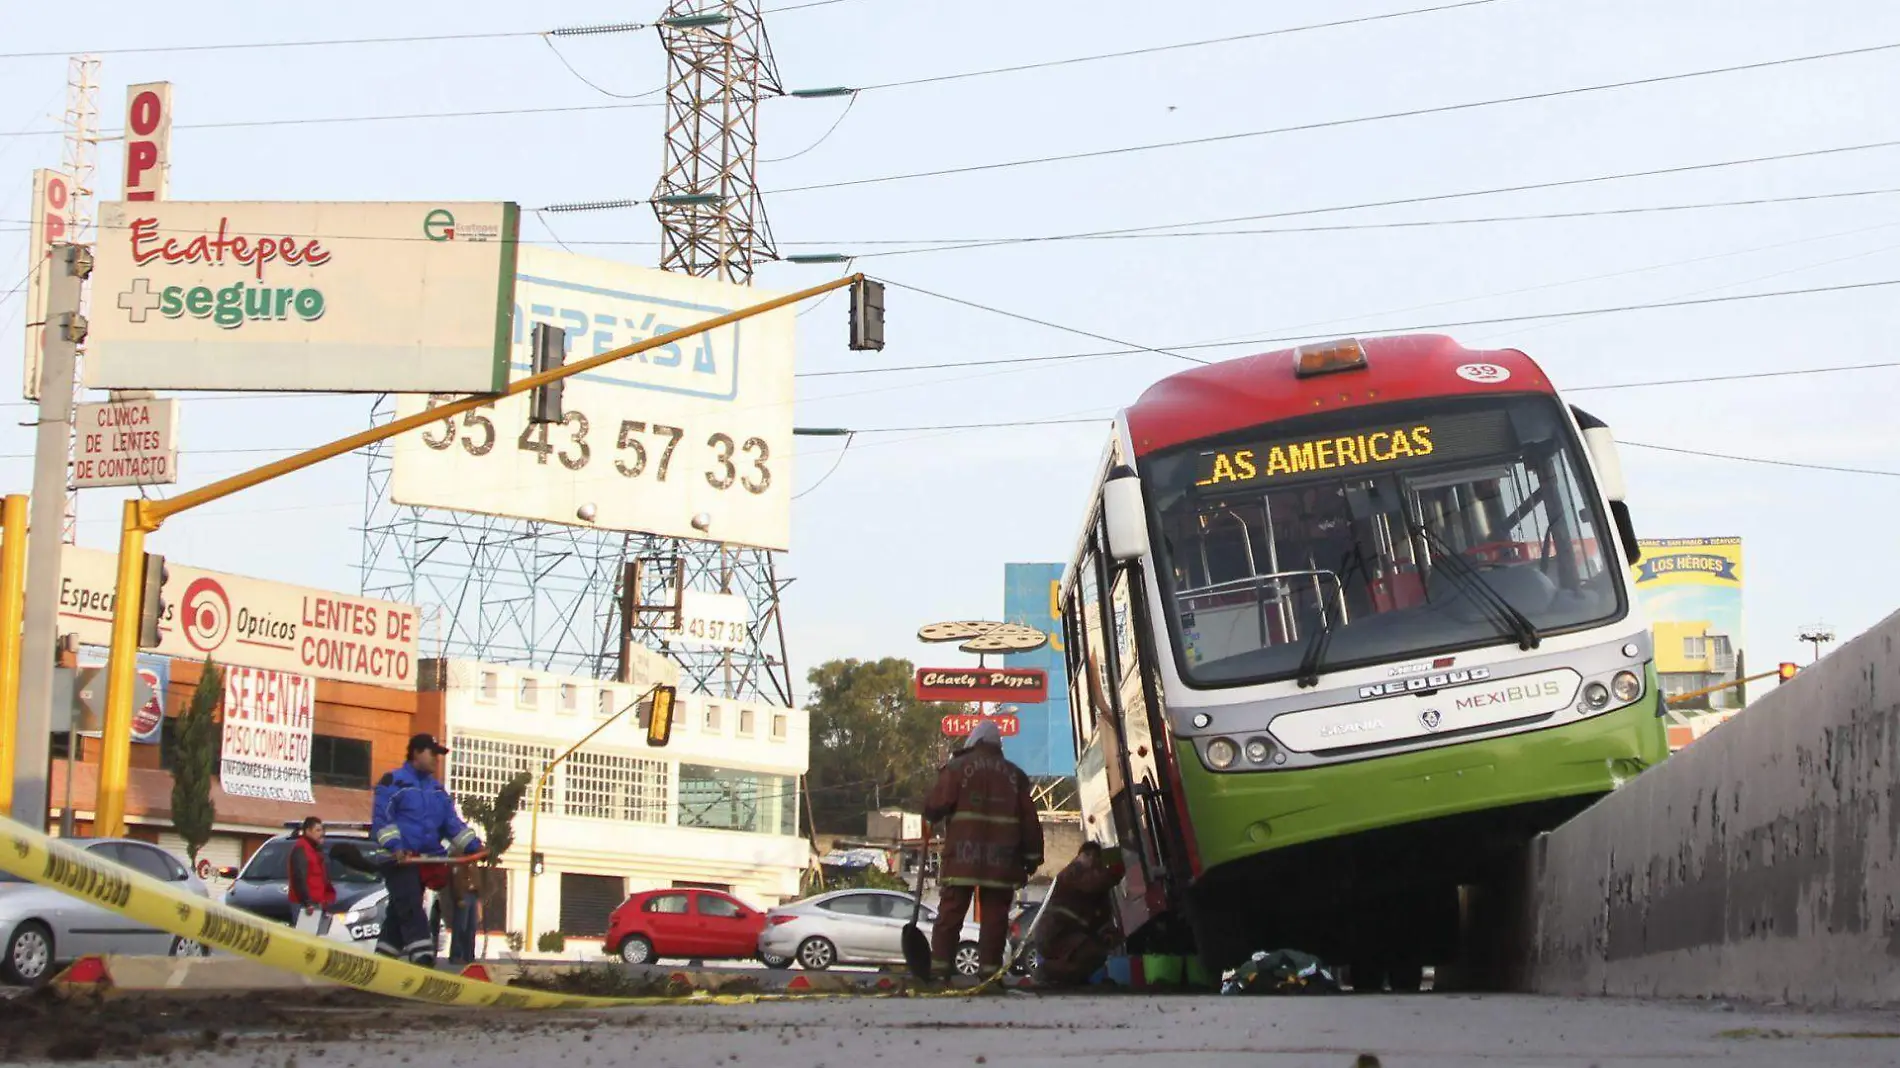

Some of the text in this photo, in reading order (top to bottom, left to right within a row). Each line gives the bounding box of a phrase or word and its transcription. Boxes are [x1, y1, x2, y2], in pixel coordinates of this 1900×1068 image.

[129, 217, 331, 283] Ecatepec
[1465, 366, 1498, 376] 39
[86, 431, 159, 453] DE LENTES
[421, 393, 771, 494] 55 43 57 33
[1267, 426, 1433, 476] AMERICAS
[77, 456, 166, 479] DE CONTACTO
[1651, 559, 1674, 573] LOS
[237, 607, 296, 640] Opticos
[302, 596, 412, 643] LENTES DE
[690, 618, 704, 638] 43
[709, 620, 724, 640] 57
[729, 623, 743, 642] 33
[301, 636, 408, 680] CONTACTO
[923, 673, 1033, 687] Charly Pizza
[1359, 667, 1490, 698] NEOBUS
[1455, 680, 1560, 711] MEXIBUS
[228, 667, 309, 728] SE RENTA
[225, 724, 308, 762] PISO COMPLETO
[351, 923, 381, 939] CES
